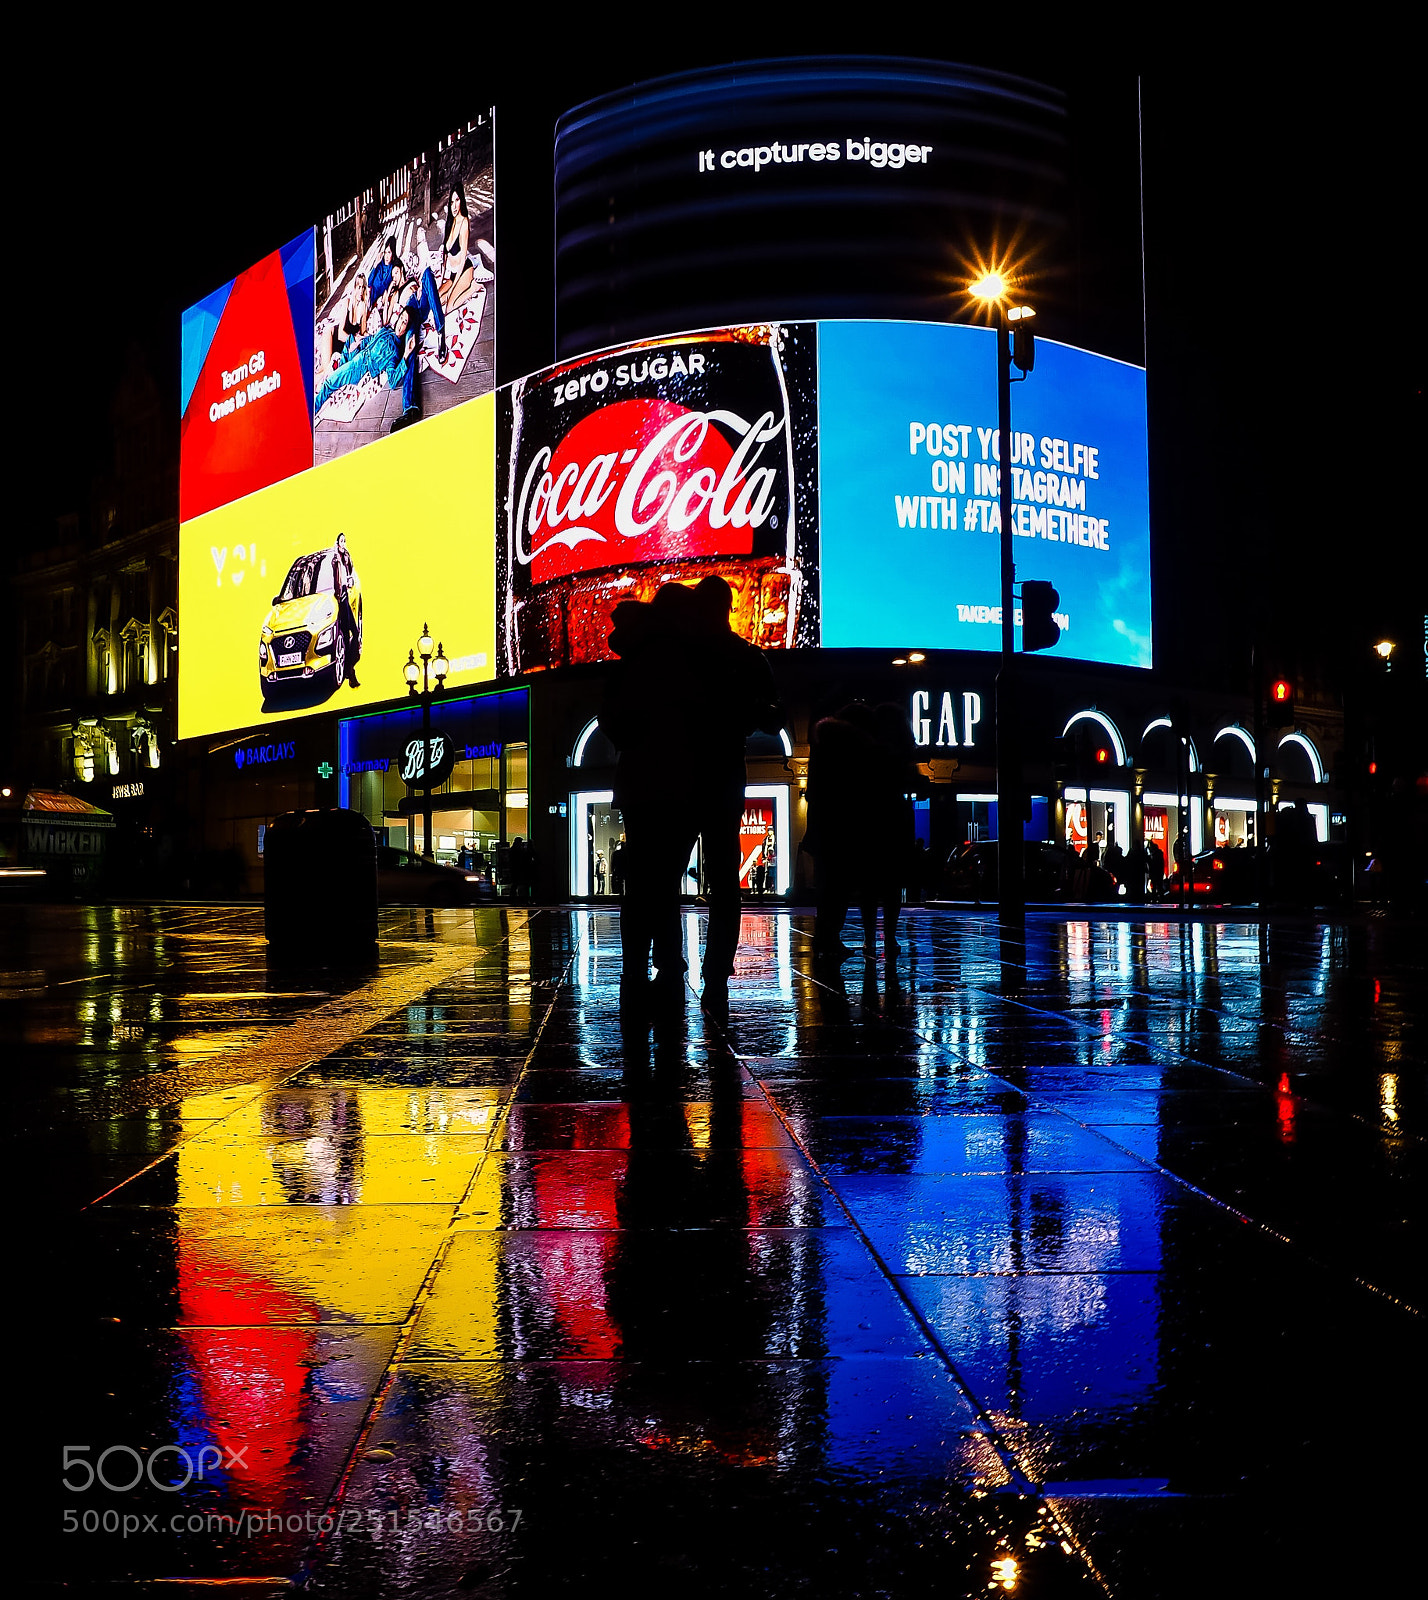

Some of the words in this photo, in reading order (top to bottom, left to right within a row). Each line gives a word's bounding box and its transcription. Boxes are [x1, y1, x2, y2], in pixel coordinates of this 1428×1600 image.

[699, 149, 715, 172] It
[720, 141, 840, 172] captures
[846, 137, 933, 168] bigger
[221, 370, 248, 390] Team
[248, 350, 265, 375] GB
[554, 370, 609, 407] zero
[616, 353, 705, 386] SUGAR
[209, 397, 235, 422] Ones
[235, 390, 247, 409] to
[246, 370, 281, 403] Watch
[909, 422, 973, 459] POST
[1040, 436, 1100, 480] SELFIE
[516, 410, 785, 565] Coca-Cola
[931, 460, 966, 495] ON
[895, 495, 957, 531] WITH
[912, 690, 981, 746] GAP
[247, 741, 296, 765] BARCLAYS
[344, 758, 389, 780] pharmacy
[402, 737, 444, 780] Bots
[465, 741, 502, 759] beauty
